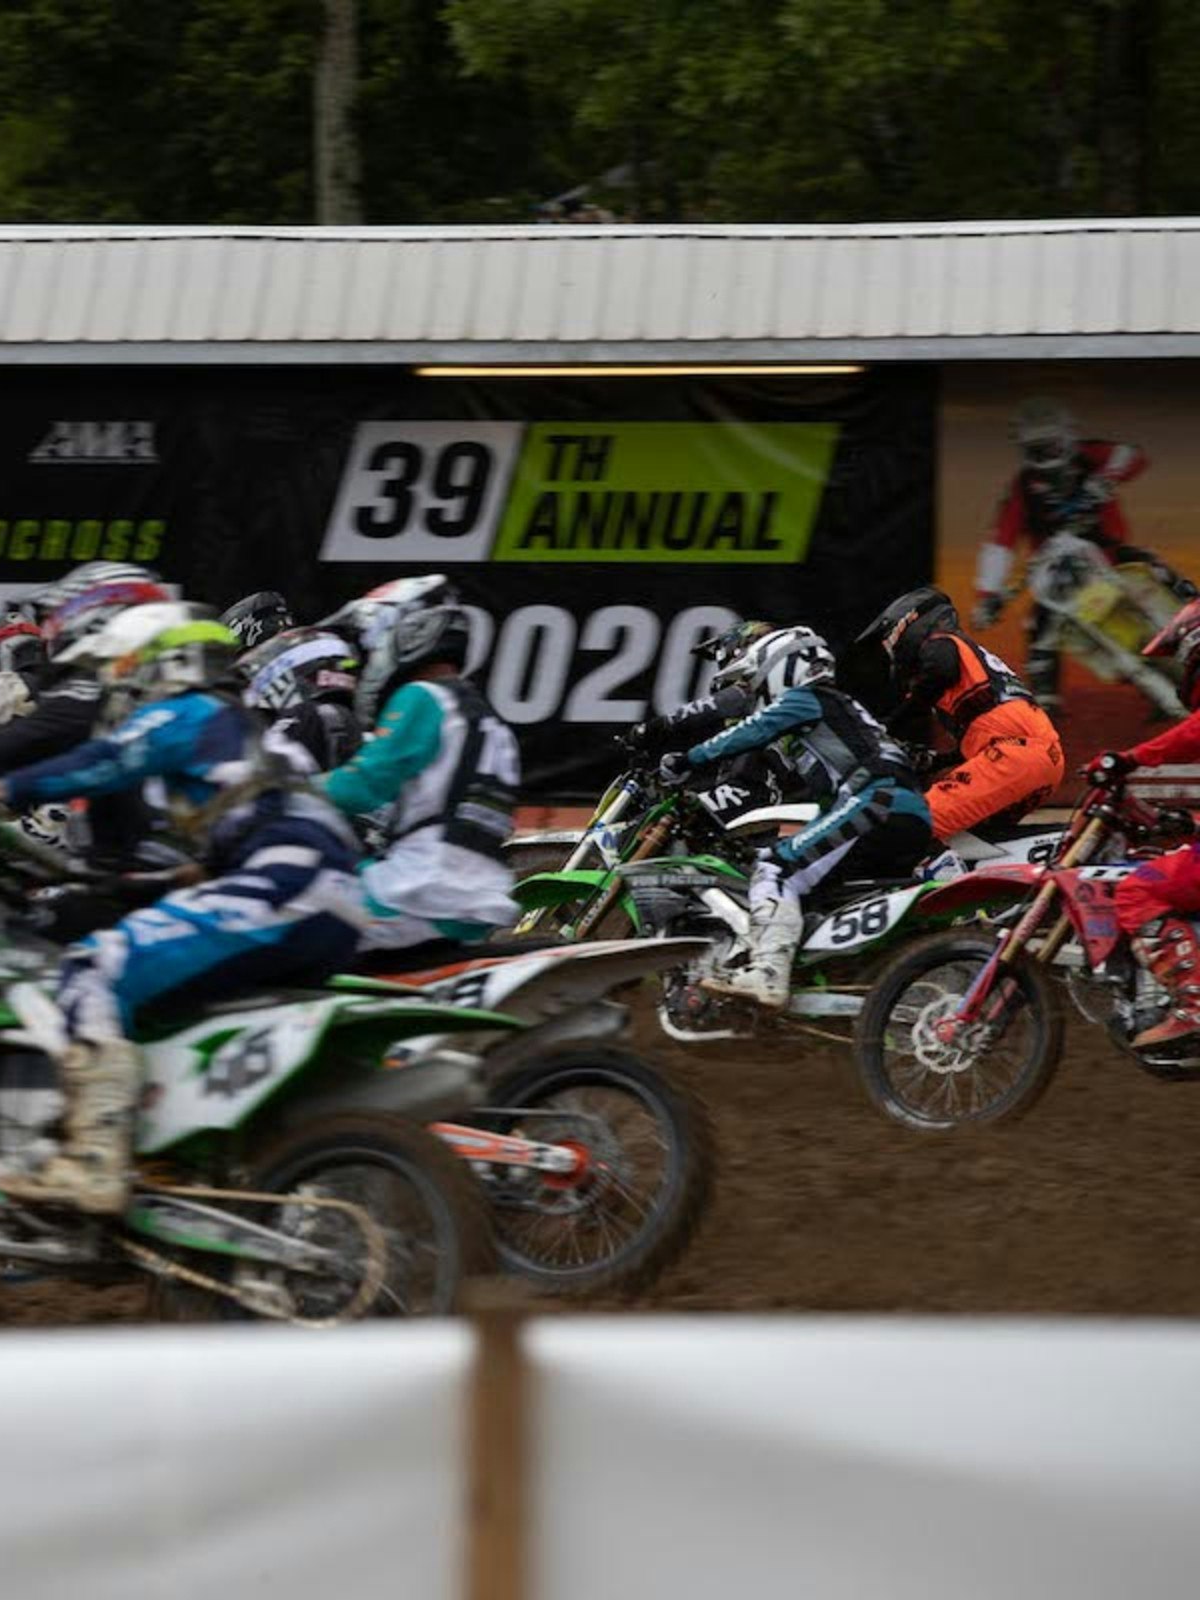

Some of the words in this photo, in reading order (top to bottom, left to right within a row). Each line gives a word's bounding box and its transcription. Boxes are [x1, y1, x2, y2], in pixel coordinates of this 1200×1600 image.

[543, 435, 615, 482] TH
[355, 441, 492, 540] 39
[515, 490, 785, 552] ANNUAL
[832, 898, 888, 943] 58
